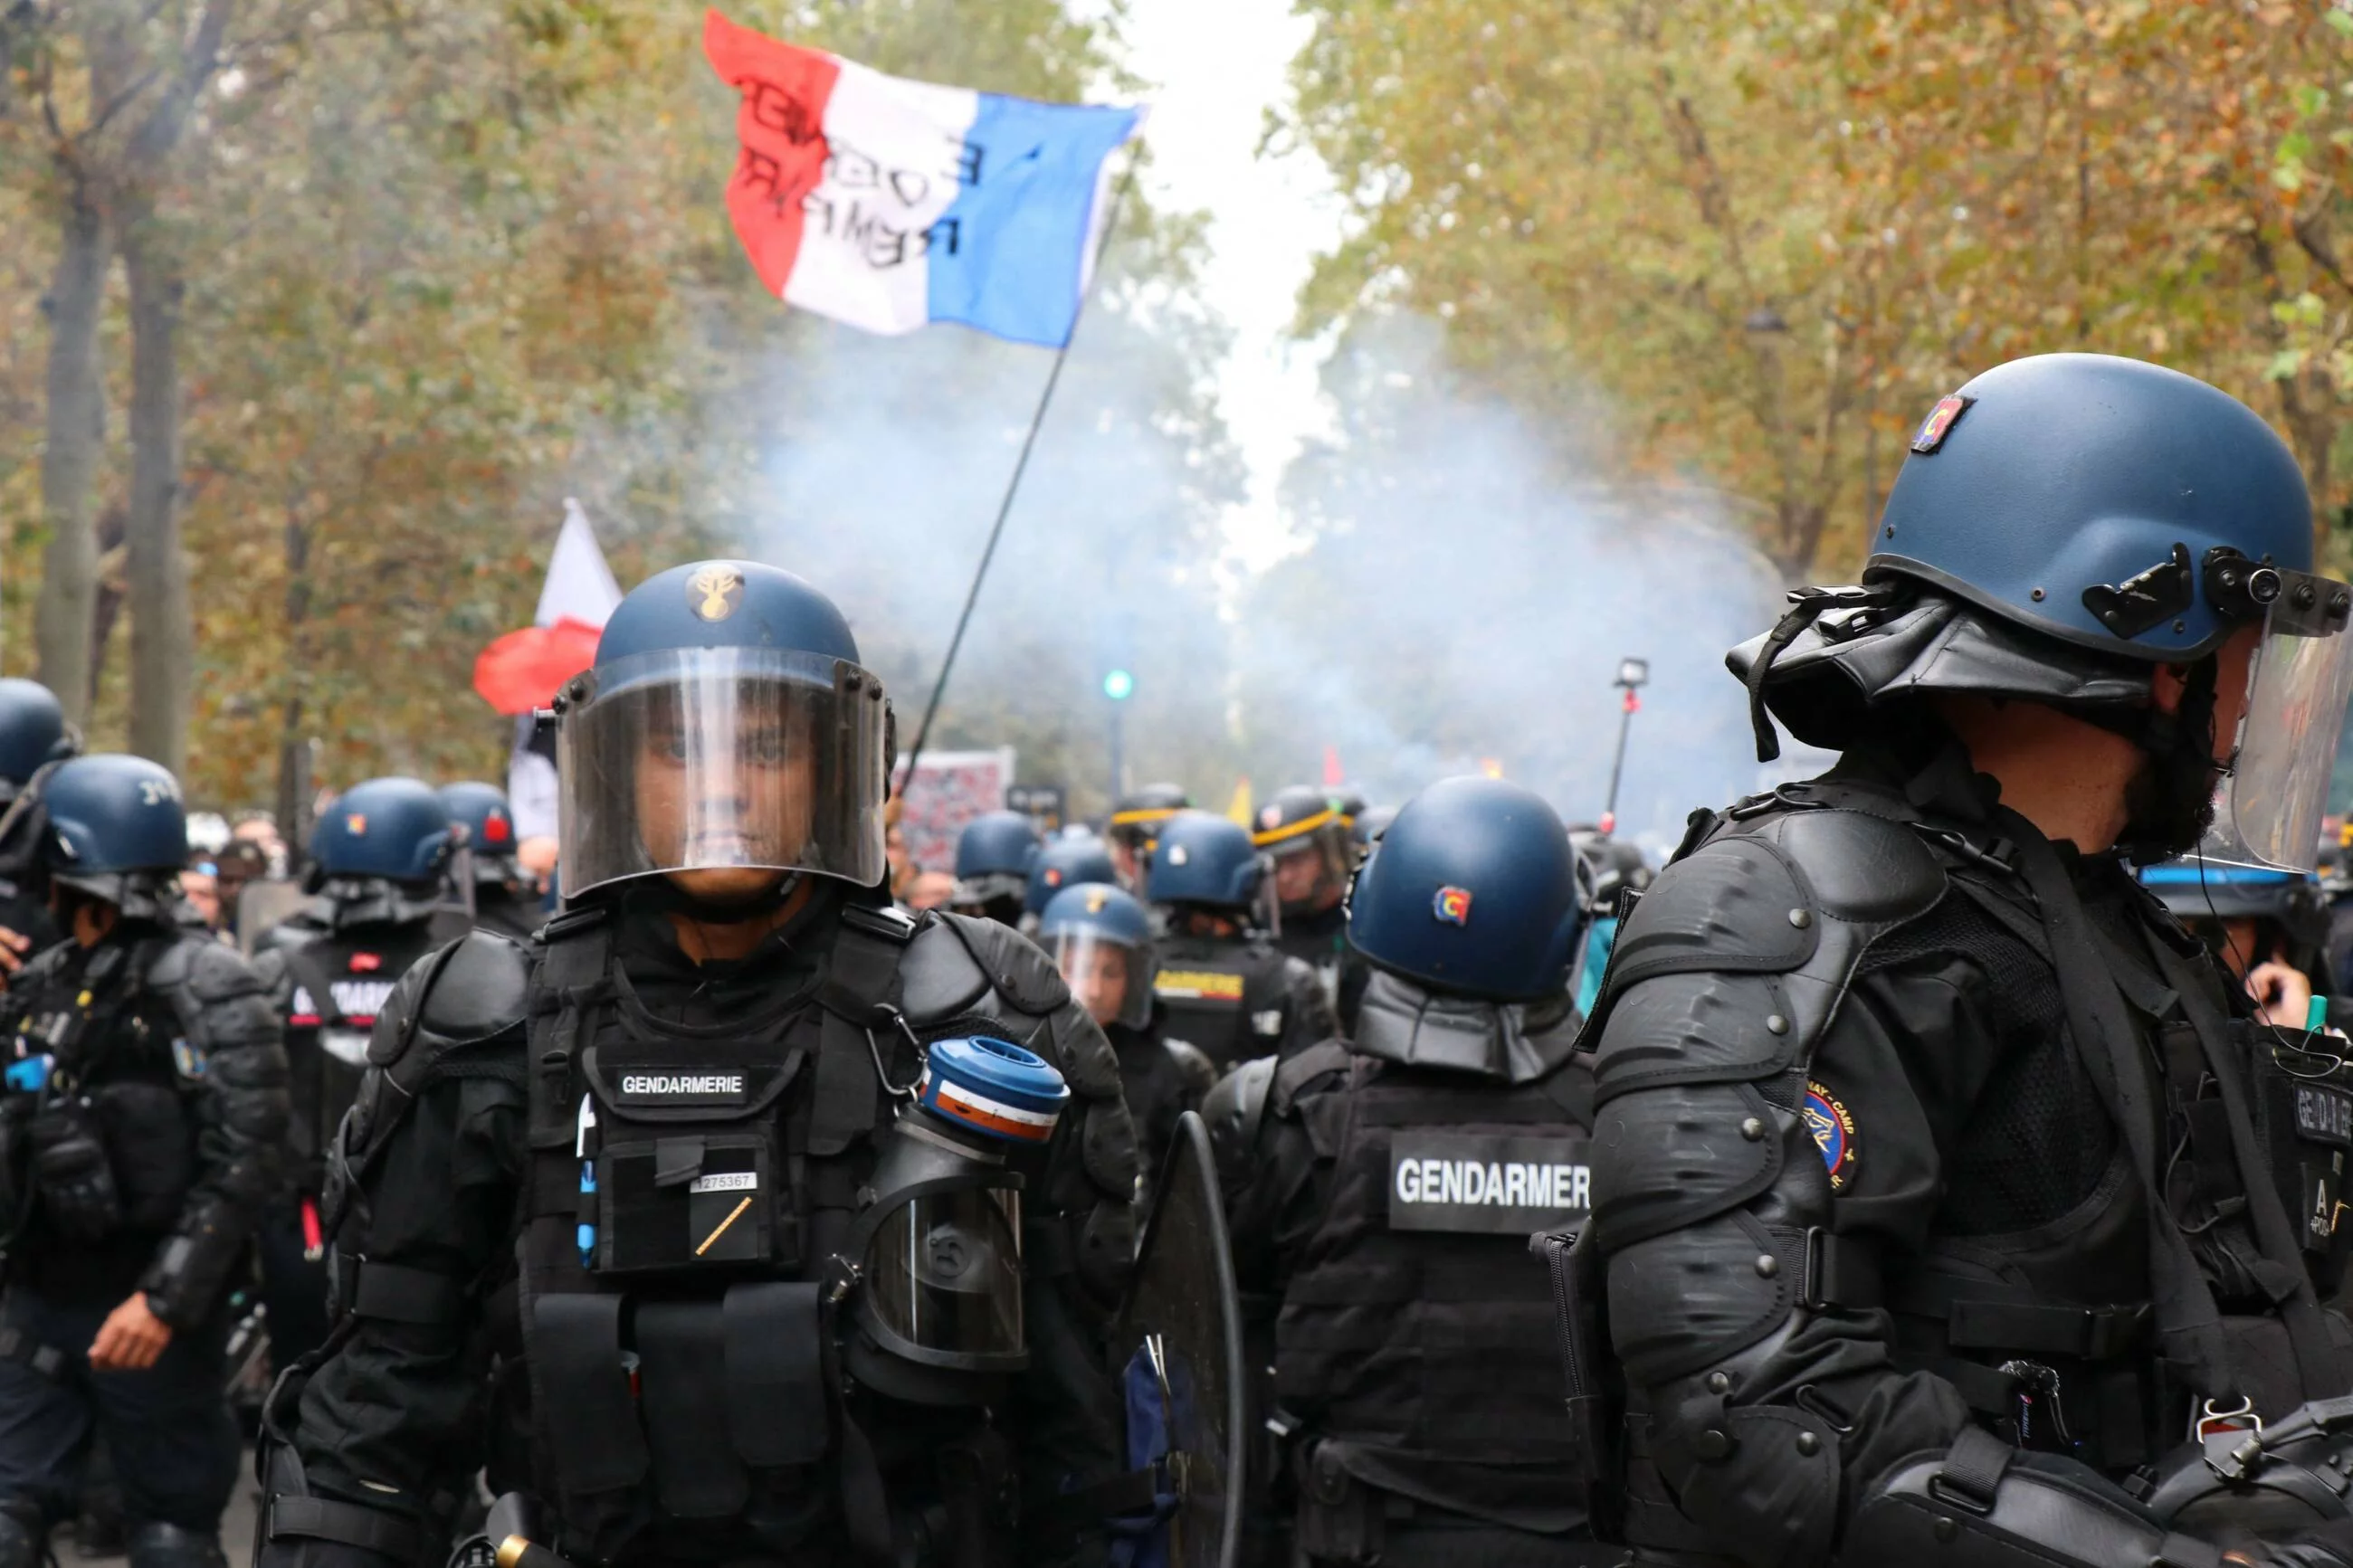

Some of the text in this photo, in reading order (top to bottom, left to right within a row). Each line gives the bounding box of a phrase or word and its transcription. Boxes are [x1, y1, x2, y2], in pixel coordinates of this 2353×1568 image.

[622, 1075, 743, 1094] GENDARMERIE
[1832, 1100, 1855, 1135] CAMP
[1396, 1157, 1591, 1210] GENDARMER
[2316, 1179, 2328, 1216] A
